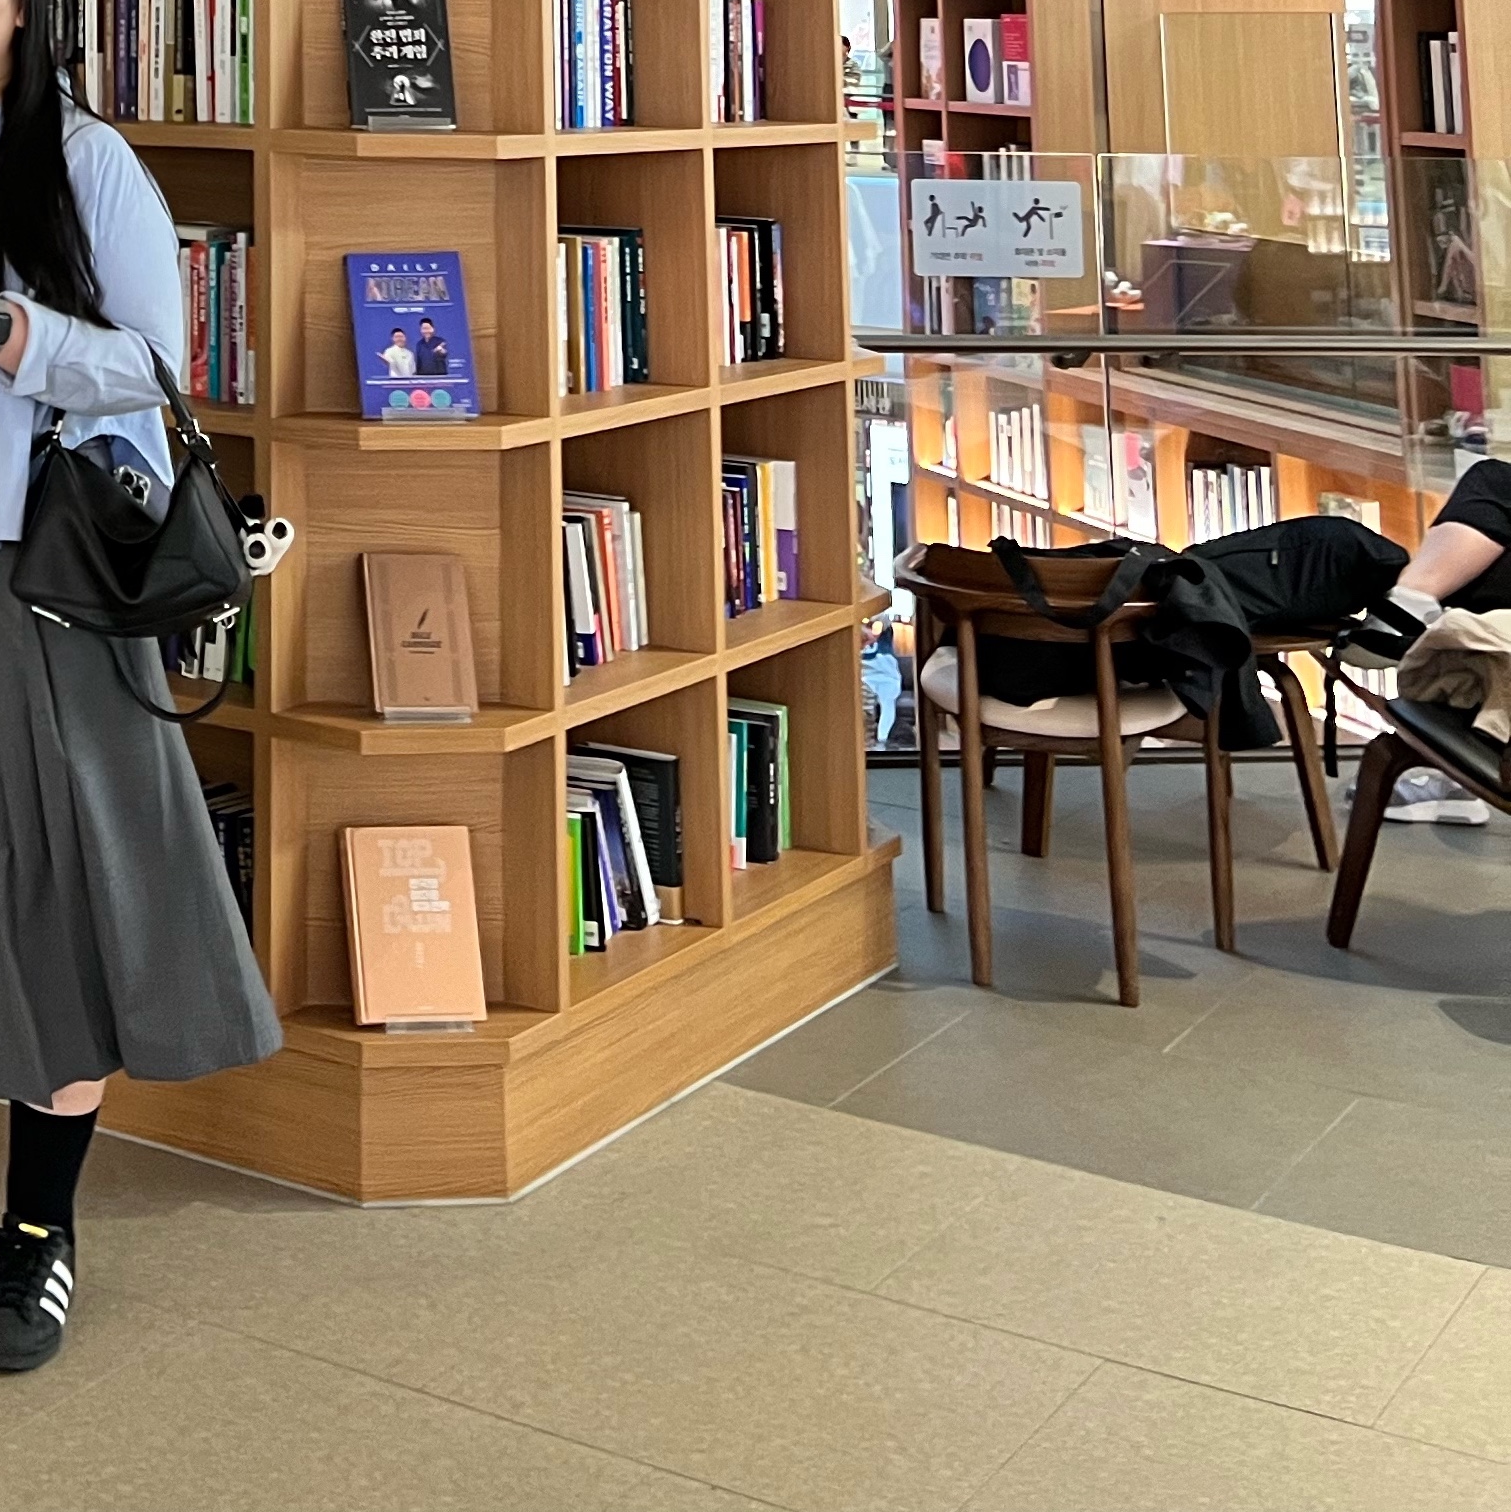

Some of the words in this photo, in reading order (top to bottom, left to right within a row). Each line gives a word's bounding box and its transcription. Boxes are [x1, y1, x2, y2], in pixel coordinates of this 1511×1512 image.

[605, 82, 615, 121] WAY
[369, 263, 439, 272] DAILY
[366, 276, 450, 302] KOREAN
